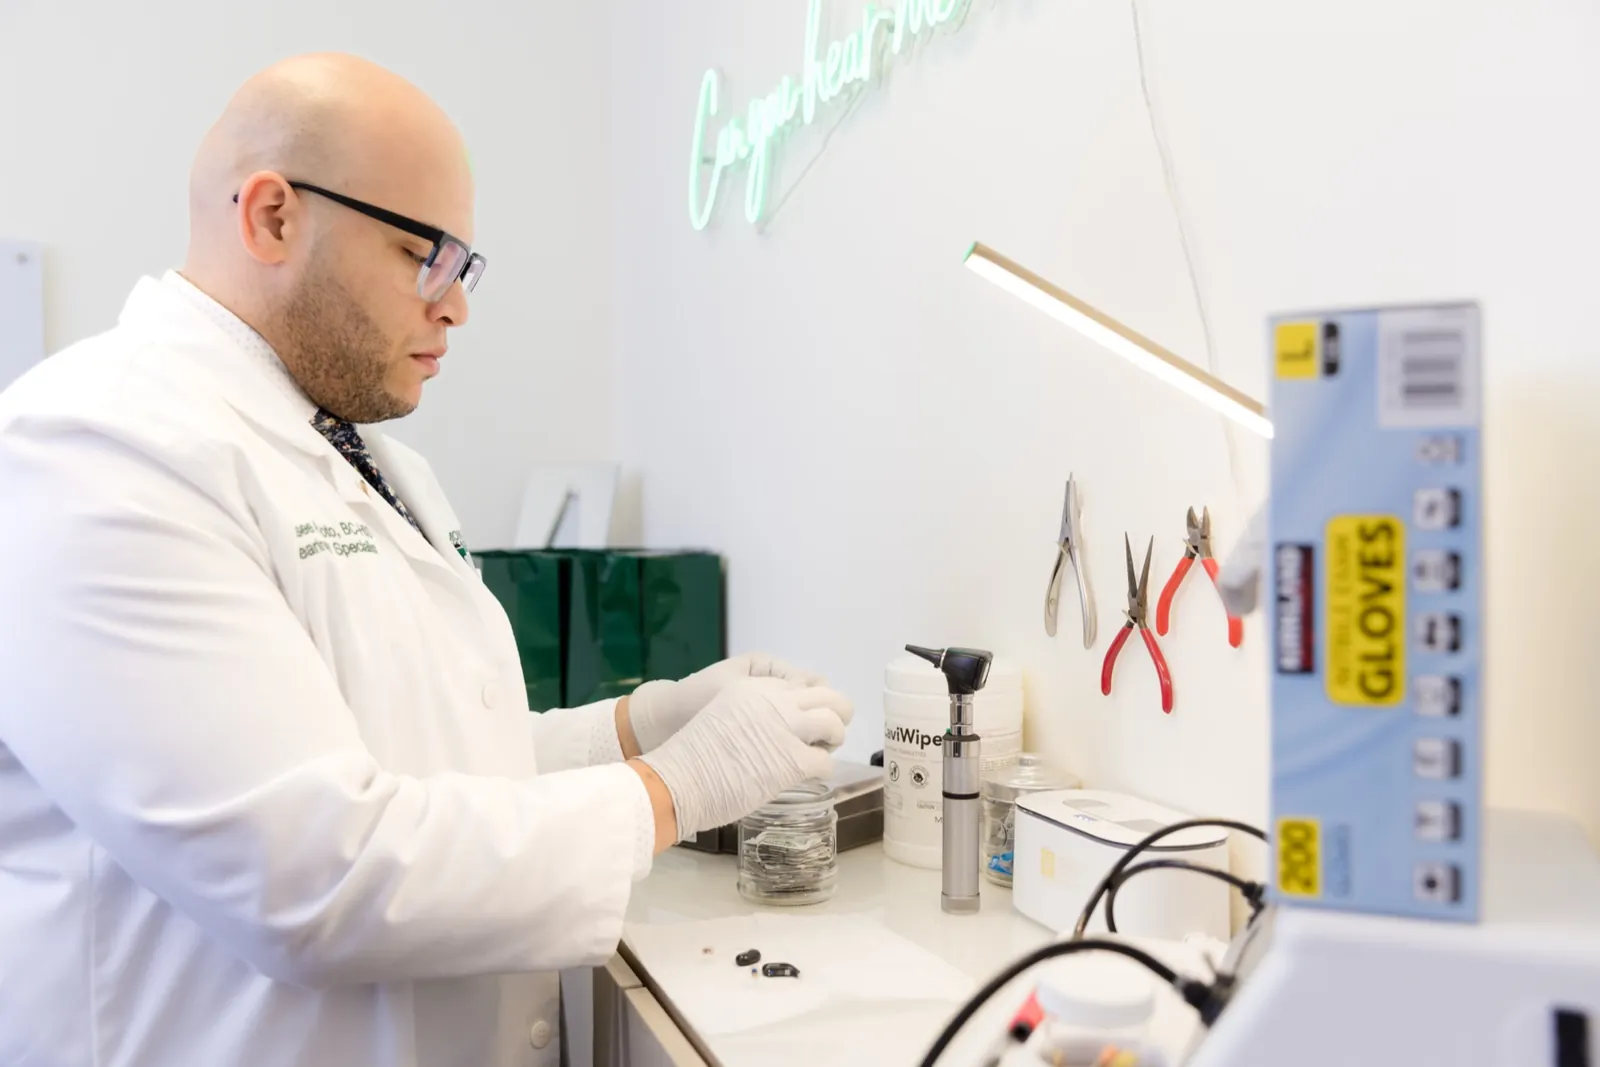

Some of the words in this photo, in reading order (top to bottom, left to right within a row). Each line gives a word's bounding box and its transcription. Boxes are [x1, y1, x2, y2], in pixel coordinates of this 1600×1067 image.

[802, 0, 894, 125] hear
[1357, 521, 1395, 700] GLOVES
[1280, 820, 1315, 892] 200
